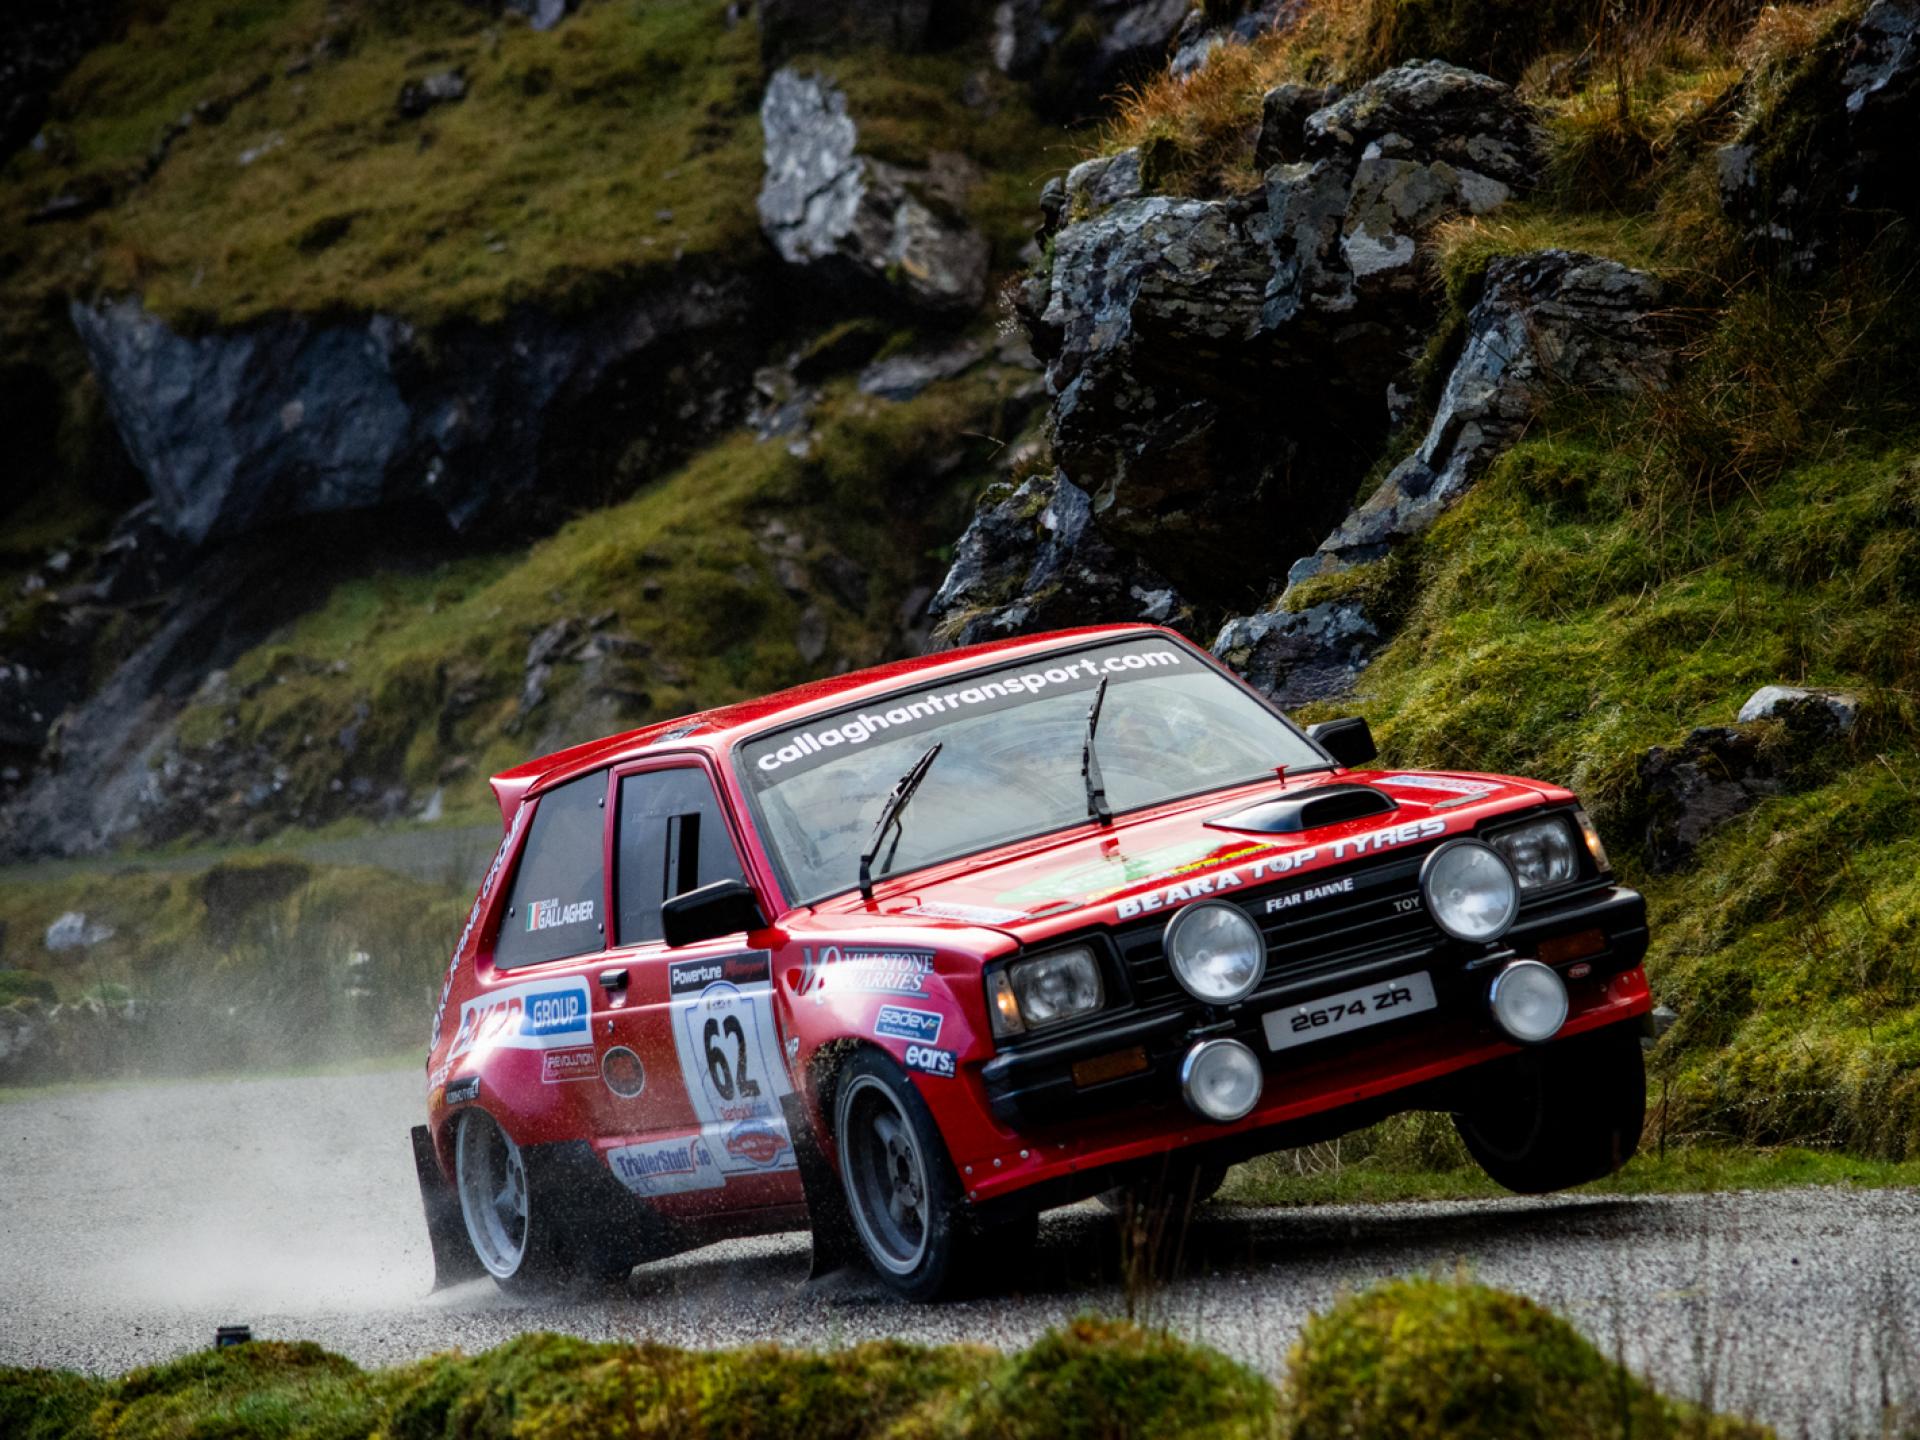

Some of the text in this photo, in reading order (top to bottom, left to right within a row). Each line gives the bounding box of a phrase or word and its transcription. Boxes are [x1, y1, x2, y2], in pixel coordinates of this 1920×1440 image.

[758, 651, 1180, 771] callaghantransport.com
[1116, 871, 1242, 919] BEARA
[1252, 849, 1317, 879] TOP
[1332, 818, 1447, 858] TYRES
[1266, 878, 1355, 913] FEAR BAINNE
[538, 900, 594, 930] GALLAGHER
[672, 965, 722, 985] Powertune
[845, 953, 935, 974] MILLSTONE
[533, 995, 579, 1028] GROUP
[880, 1010, 933, 1029] sadev
[1291, 987, 1413, 1033] 2674 ZR
[703, 1015, 761, 1101] 62
